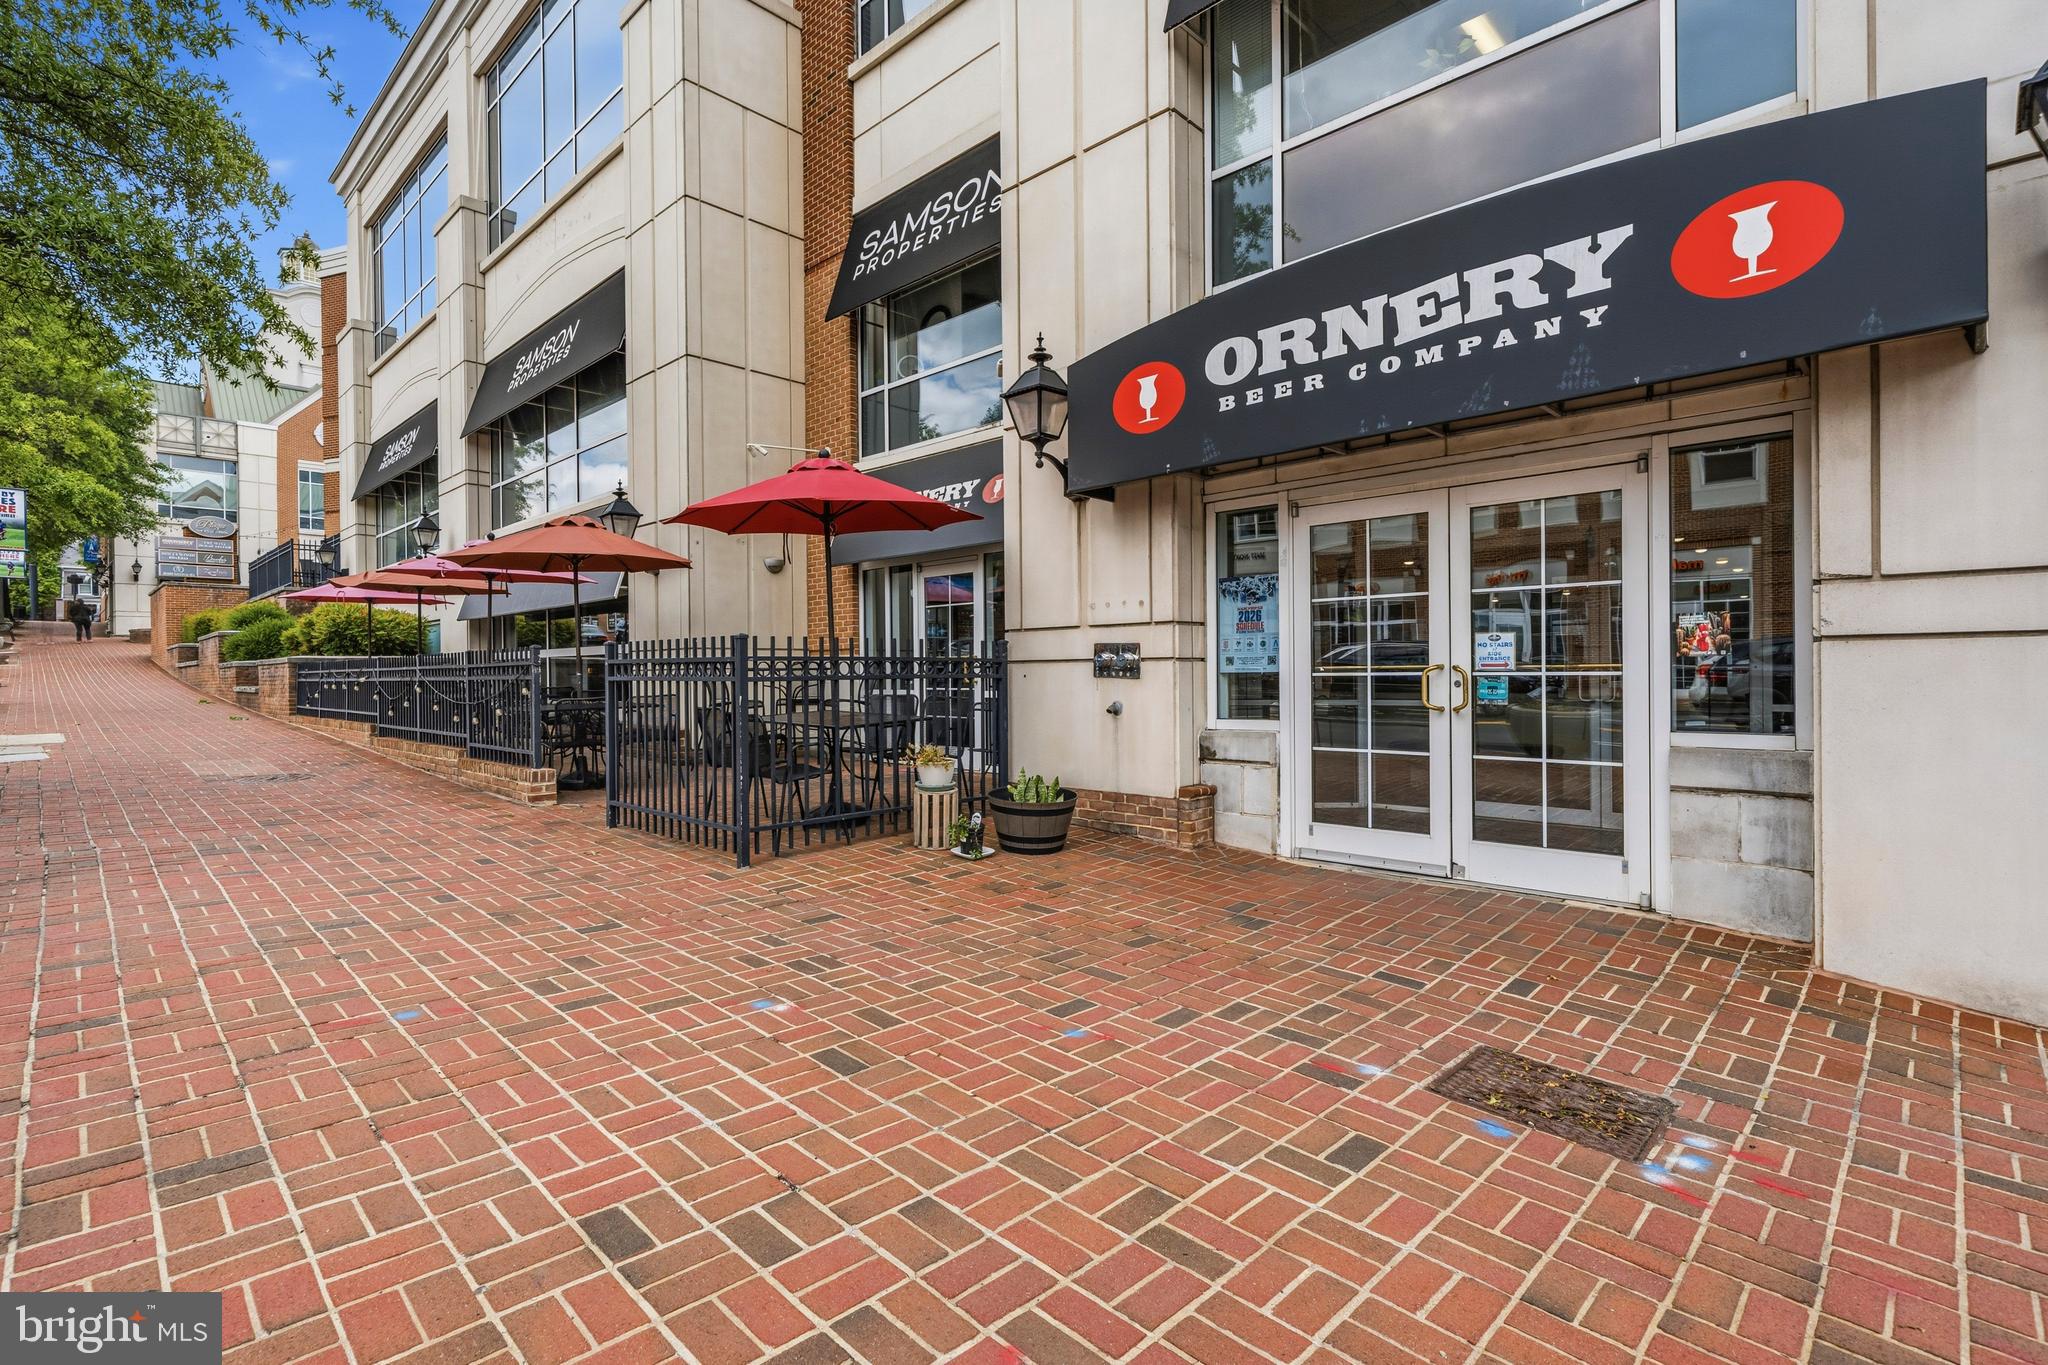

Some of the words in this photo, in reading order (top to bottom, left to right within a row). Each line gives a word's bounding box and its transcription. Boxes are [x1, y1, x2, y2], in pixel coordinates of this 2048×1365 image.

[853, 194, 1002, 281] PROPERTIES
[1205, 223, 1634, 386] ORNERY
[507, 344, 571, 393] PROPERTIES
[512, 319, 580, 379] SAMSON
[1218, 373, 1324, 412] BEER
[1348, 304, 1609, 382] COMPANY
[377, 444, 413, 472] PROPERTIES
[382, 425, 421, 462] SAMSON
[1236, 622, 1264, 631] SCHEDULE
[1238, 609, 1262, 623] 2026
